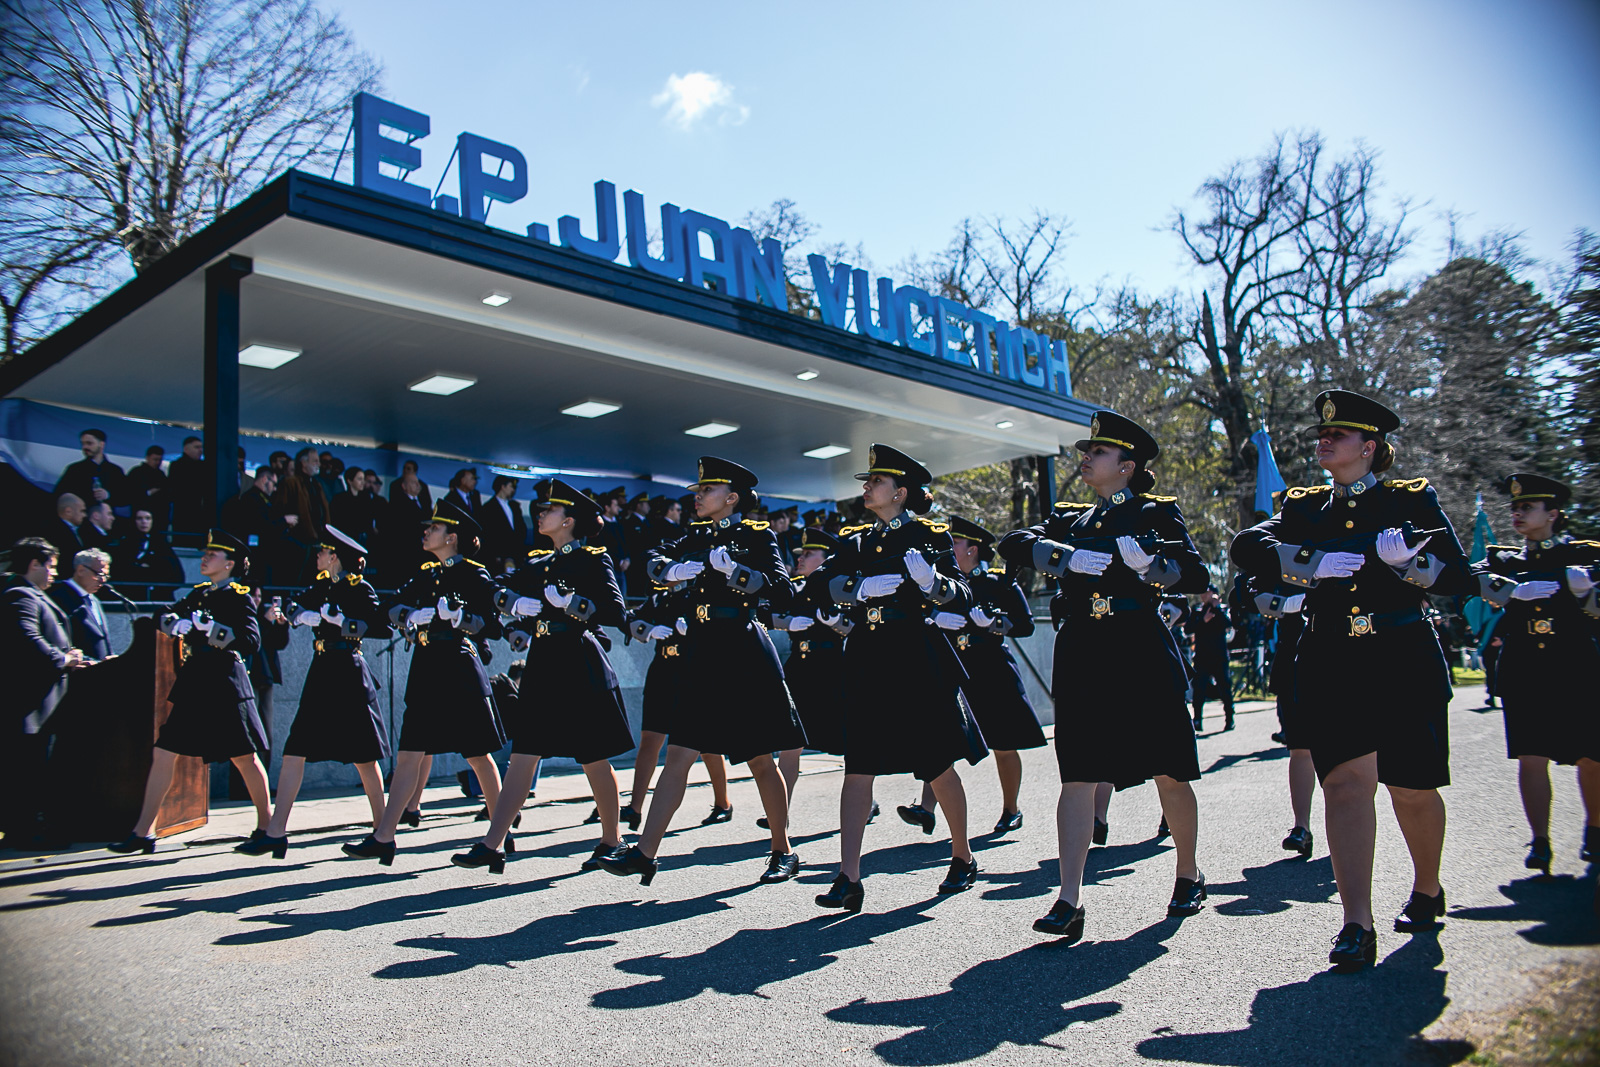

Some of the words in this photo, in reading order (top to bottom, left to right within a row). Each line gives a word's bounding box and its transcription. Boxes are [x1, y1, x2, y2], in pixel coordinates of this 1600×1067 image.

[353, 91, 549, 245] E.P.
[558, 178, 788, 312] JUAN
[807, 253, 1072, 397] VUCETICH
